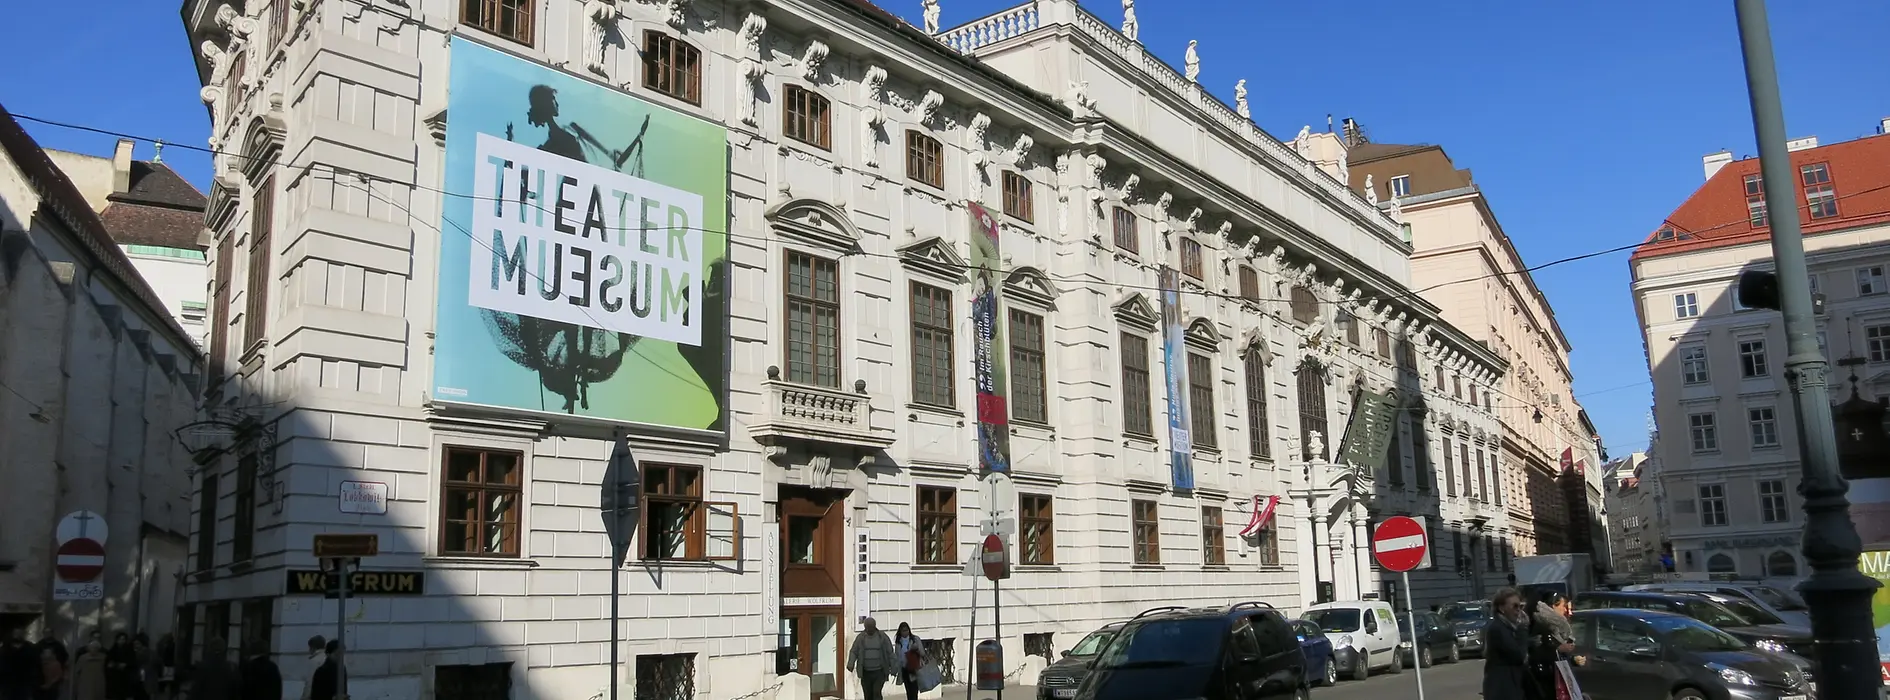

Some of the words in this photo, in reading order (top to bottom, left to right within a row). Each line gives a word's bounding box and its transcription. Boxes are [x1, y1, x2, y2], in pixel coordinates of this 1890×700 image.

[488, 155, 690, 262] THEATER
[977, 320, 985, 357] Rausch
[986, 375, 994, 392] der
[296, 572, 417, 592] WFRUM
[767, 531, 775, 625] AUSSTELLUNG
